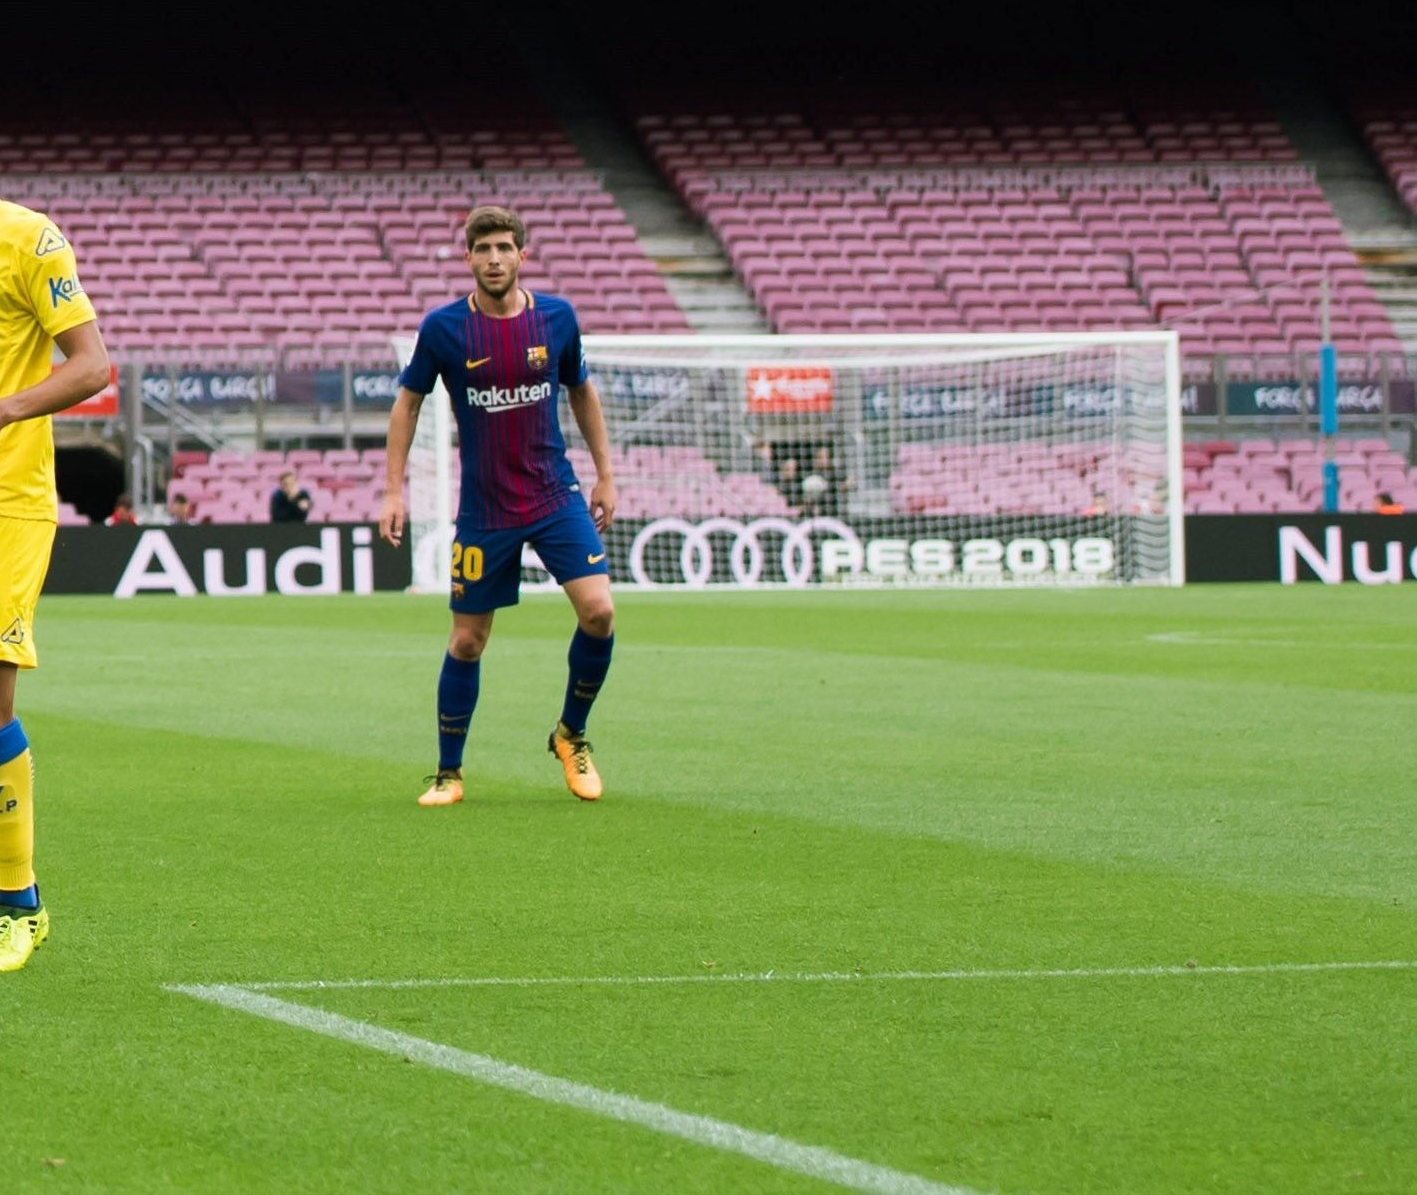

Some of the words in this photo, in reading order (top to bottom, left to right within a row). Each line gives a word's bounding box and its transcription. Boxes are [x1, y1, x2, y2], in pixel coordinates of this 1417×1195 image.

[467, 381, 552, 409] Rakuten
[113, 527, 373, 600] Audi
[451, 542, 483, 582] 20
[961, 536, 1114, 576] 2018
[1279, 526, 1417, 586] Nu
